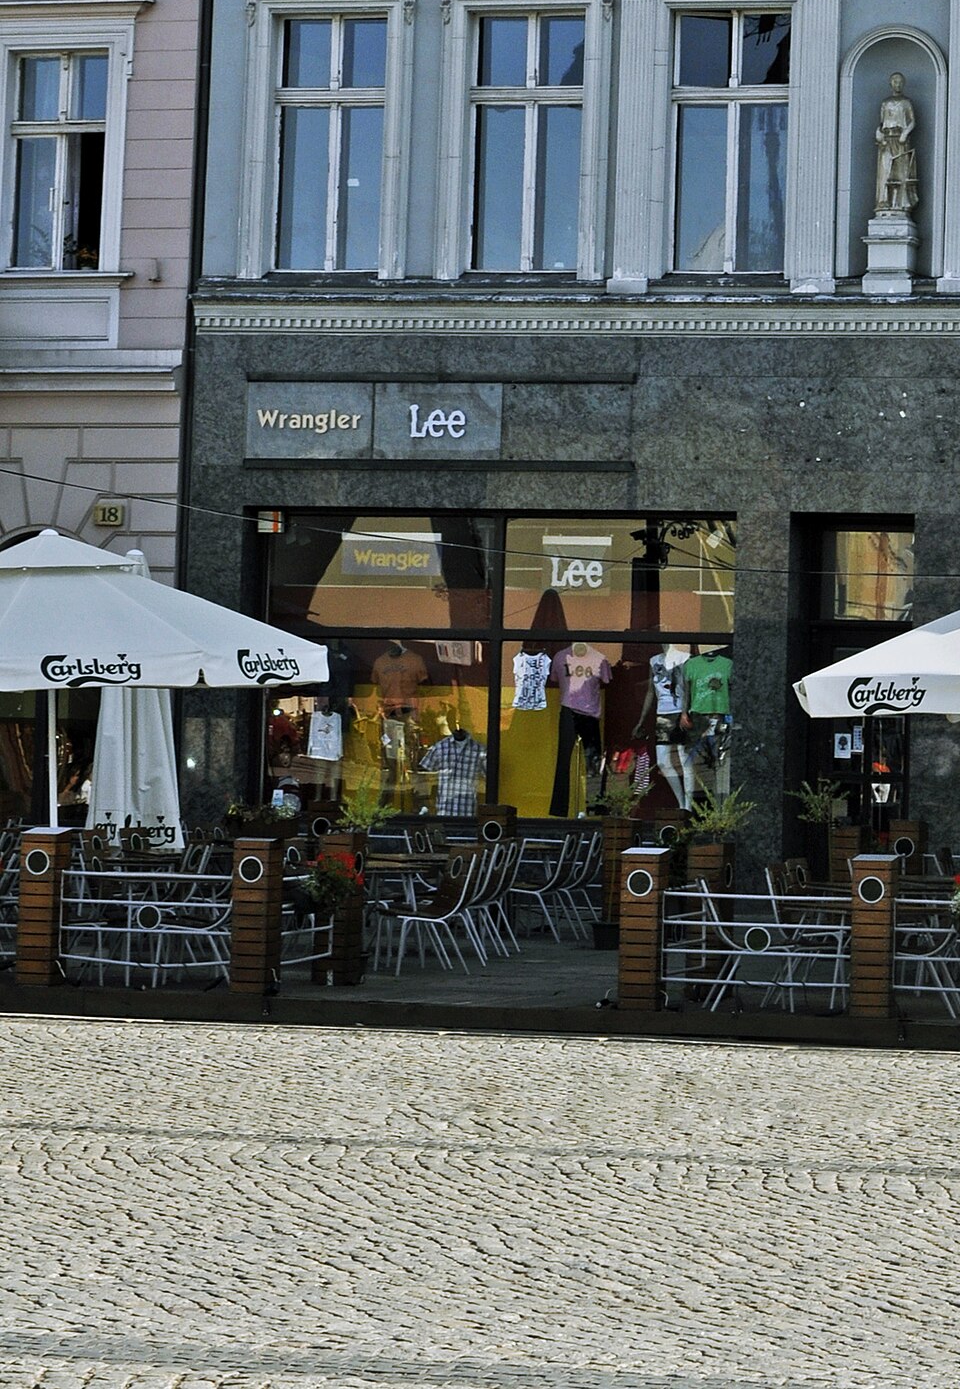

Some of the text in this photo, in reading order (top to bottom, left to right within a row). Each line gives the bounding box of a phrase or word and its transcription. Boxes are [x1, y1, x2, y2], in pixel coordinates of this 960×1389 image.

[257, 409, 362, 434] Wrangler
[409, 404, 466, 439] Lee
[99, 506, 119, 523] 18
[354, 549, 430, 570] Wrangler
[551, 556, 603, 589] Lee
[40, 654, 142, 686] Carlsberg
[237, 649, 300, 683] Carlsberg
[847, 677, 927, 713] Carlsberg
